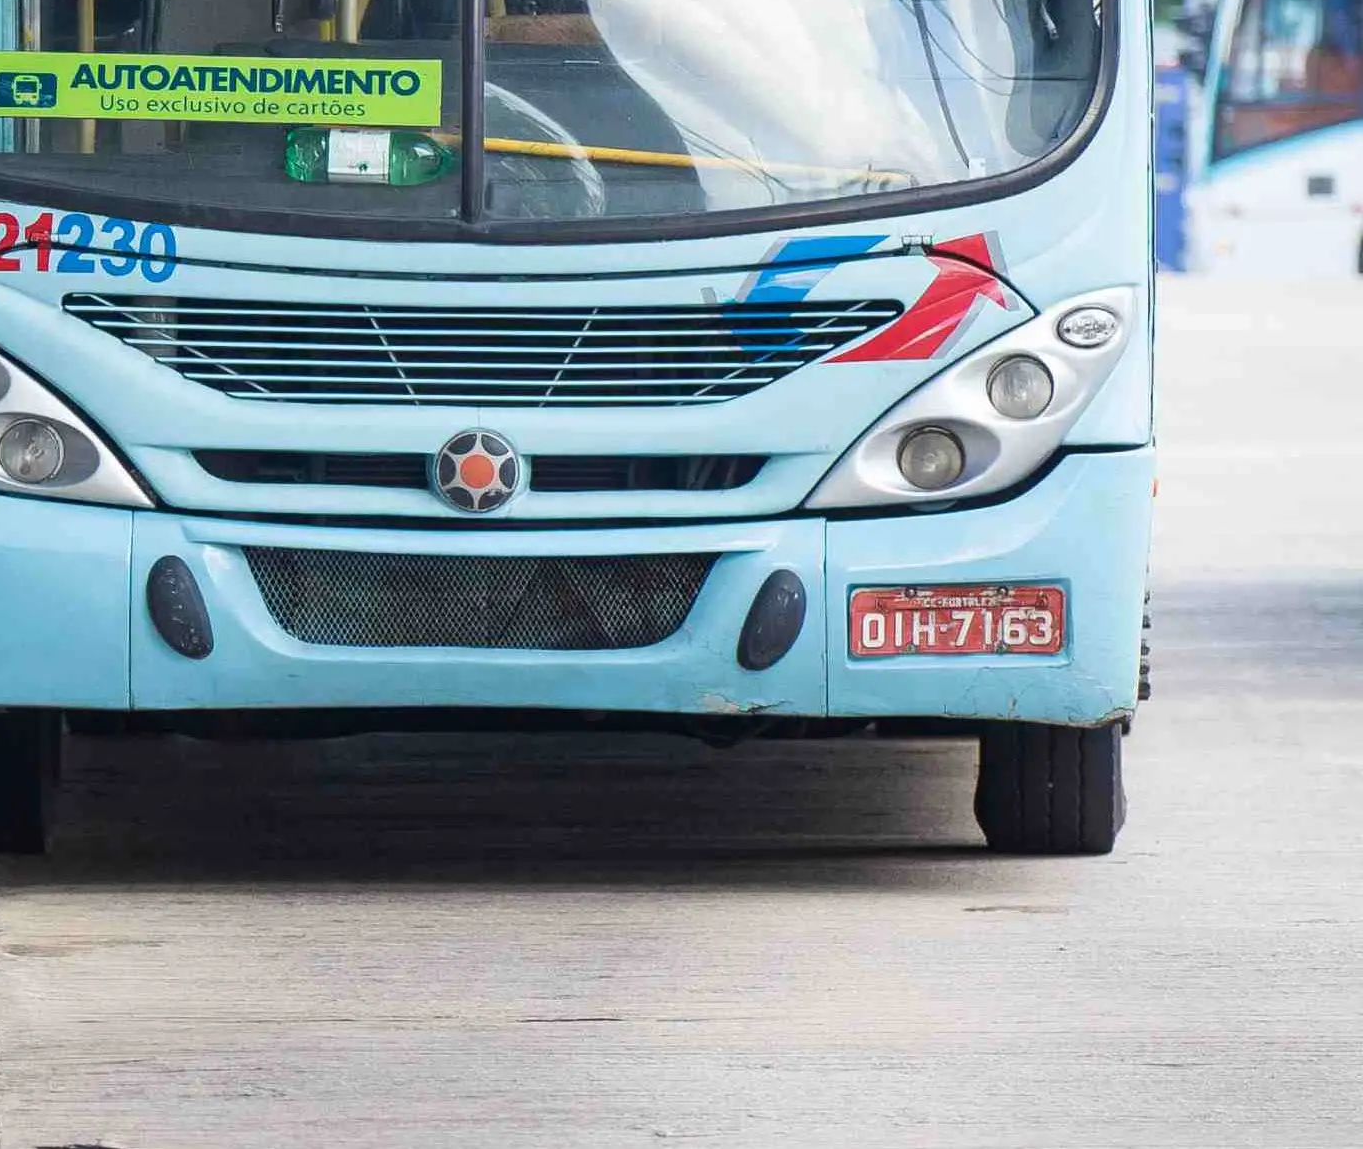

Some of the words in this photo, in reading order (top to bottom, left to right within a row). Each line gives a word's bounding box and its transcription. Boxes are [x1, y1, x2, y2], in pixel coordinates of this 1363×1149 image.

[70, 63, 421, 96] AUTOATENDIMENTO
[100, 95, 139, 112] Uso
[146, 96, 245, 114] exclusivo
[253, 97, 280, 115] de
[286, 99, 366, 117] cartões
[861, 609, 1054, 649] OIH-7163
